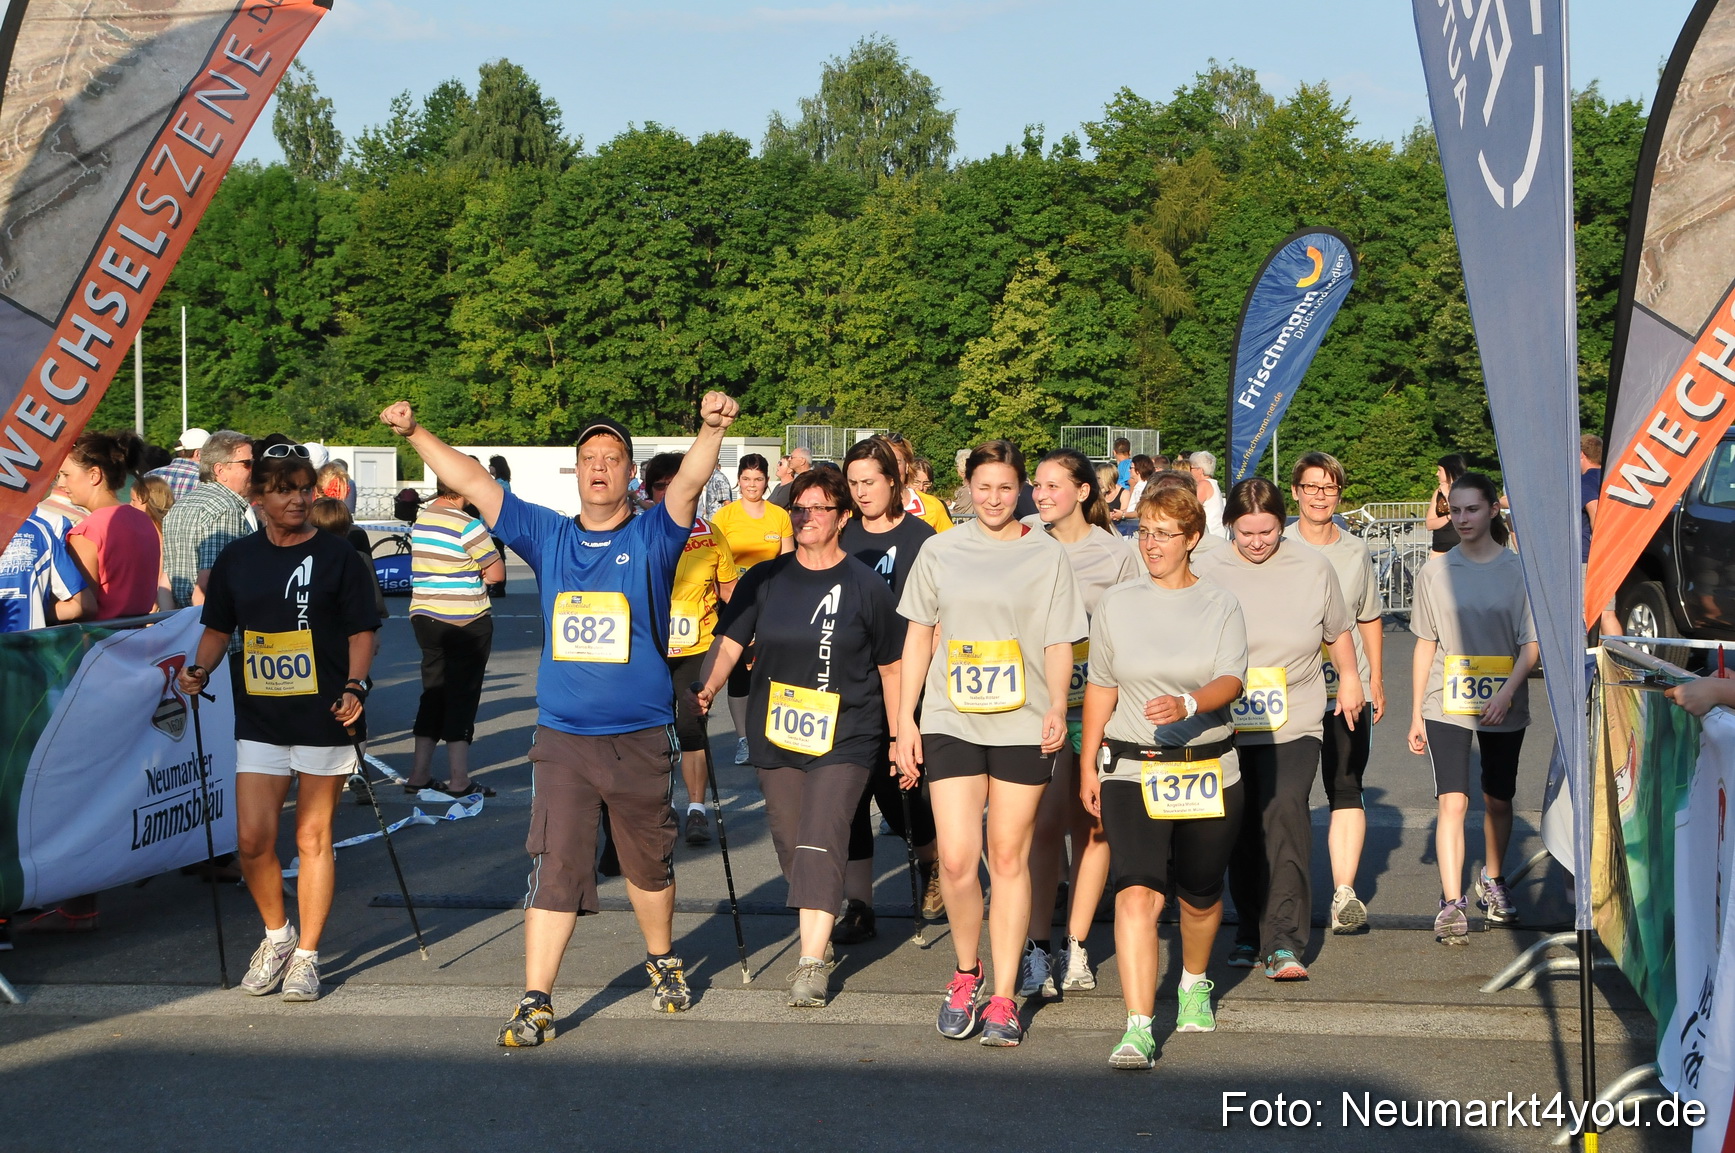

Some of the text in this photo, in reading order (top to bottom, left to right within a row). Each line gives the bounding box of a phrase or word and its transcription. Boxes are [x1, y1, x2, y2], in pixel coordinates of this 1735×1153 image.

[0, 0, 283, 492] WECHSELSZENE.D
[1294, 311, 1315, 339] Druck
[1238, 291, 1319, 409] Frischmann
[1605, 299, 1735, 508] WECH
[1236, 391, 1283, 480] www.frischmann-net.de
[563, 616, 616, 644] 682
[246, 653, 312, 680] 1060
[950, 665, 1016, 694] 1371
[1447, 676, 1509, 700] 1367
[771, 706, 829, 741] 1061
[145, 752, 213, 798] Neumarker
[1145, 772, 1218, 802] 1370
[131, 782, 223, 851] Lammsbäu
